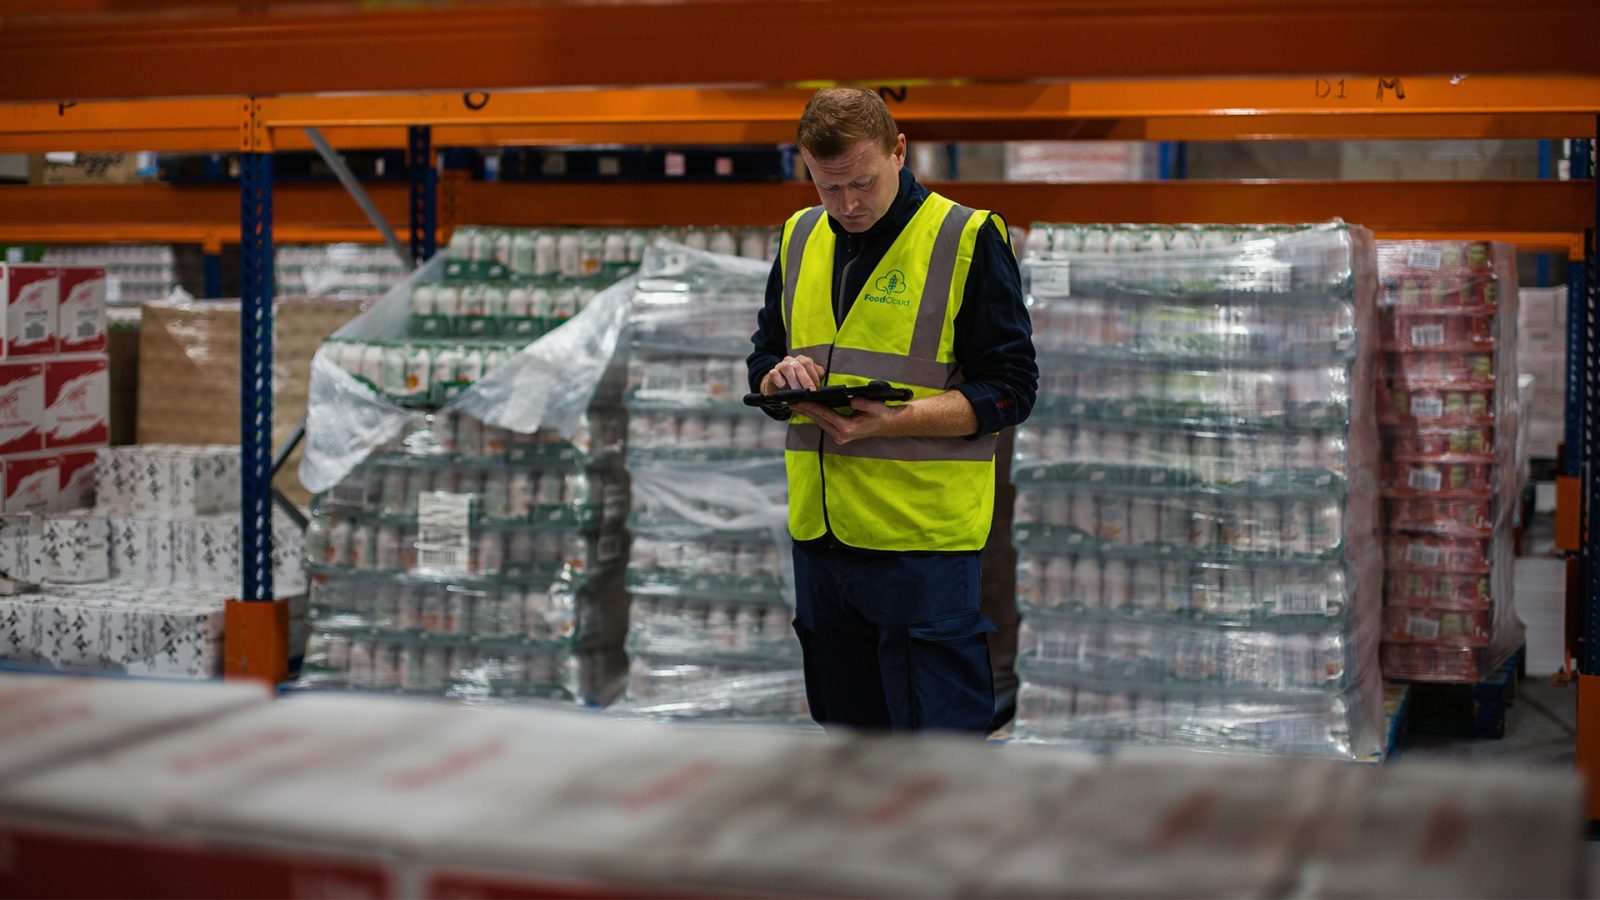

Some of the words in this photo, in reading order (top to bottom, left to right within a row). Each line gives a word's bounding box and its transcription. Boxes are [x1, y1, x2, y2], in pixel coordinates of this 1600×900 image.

[1315, 78, 1346, 99] D1
[1376, 76, 1405, 102] M
[864, 293, 910, 306] FoodCloud
